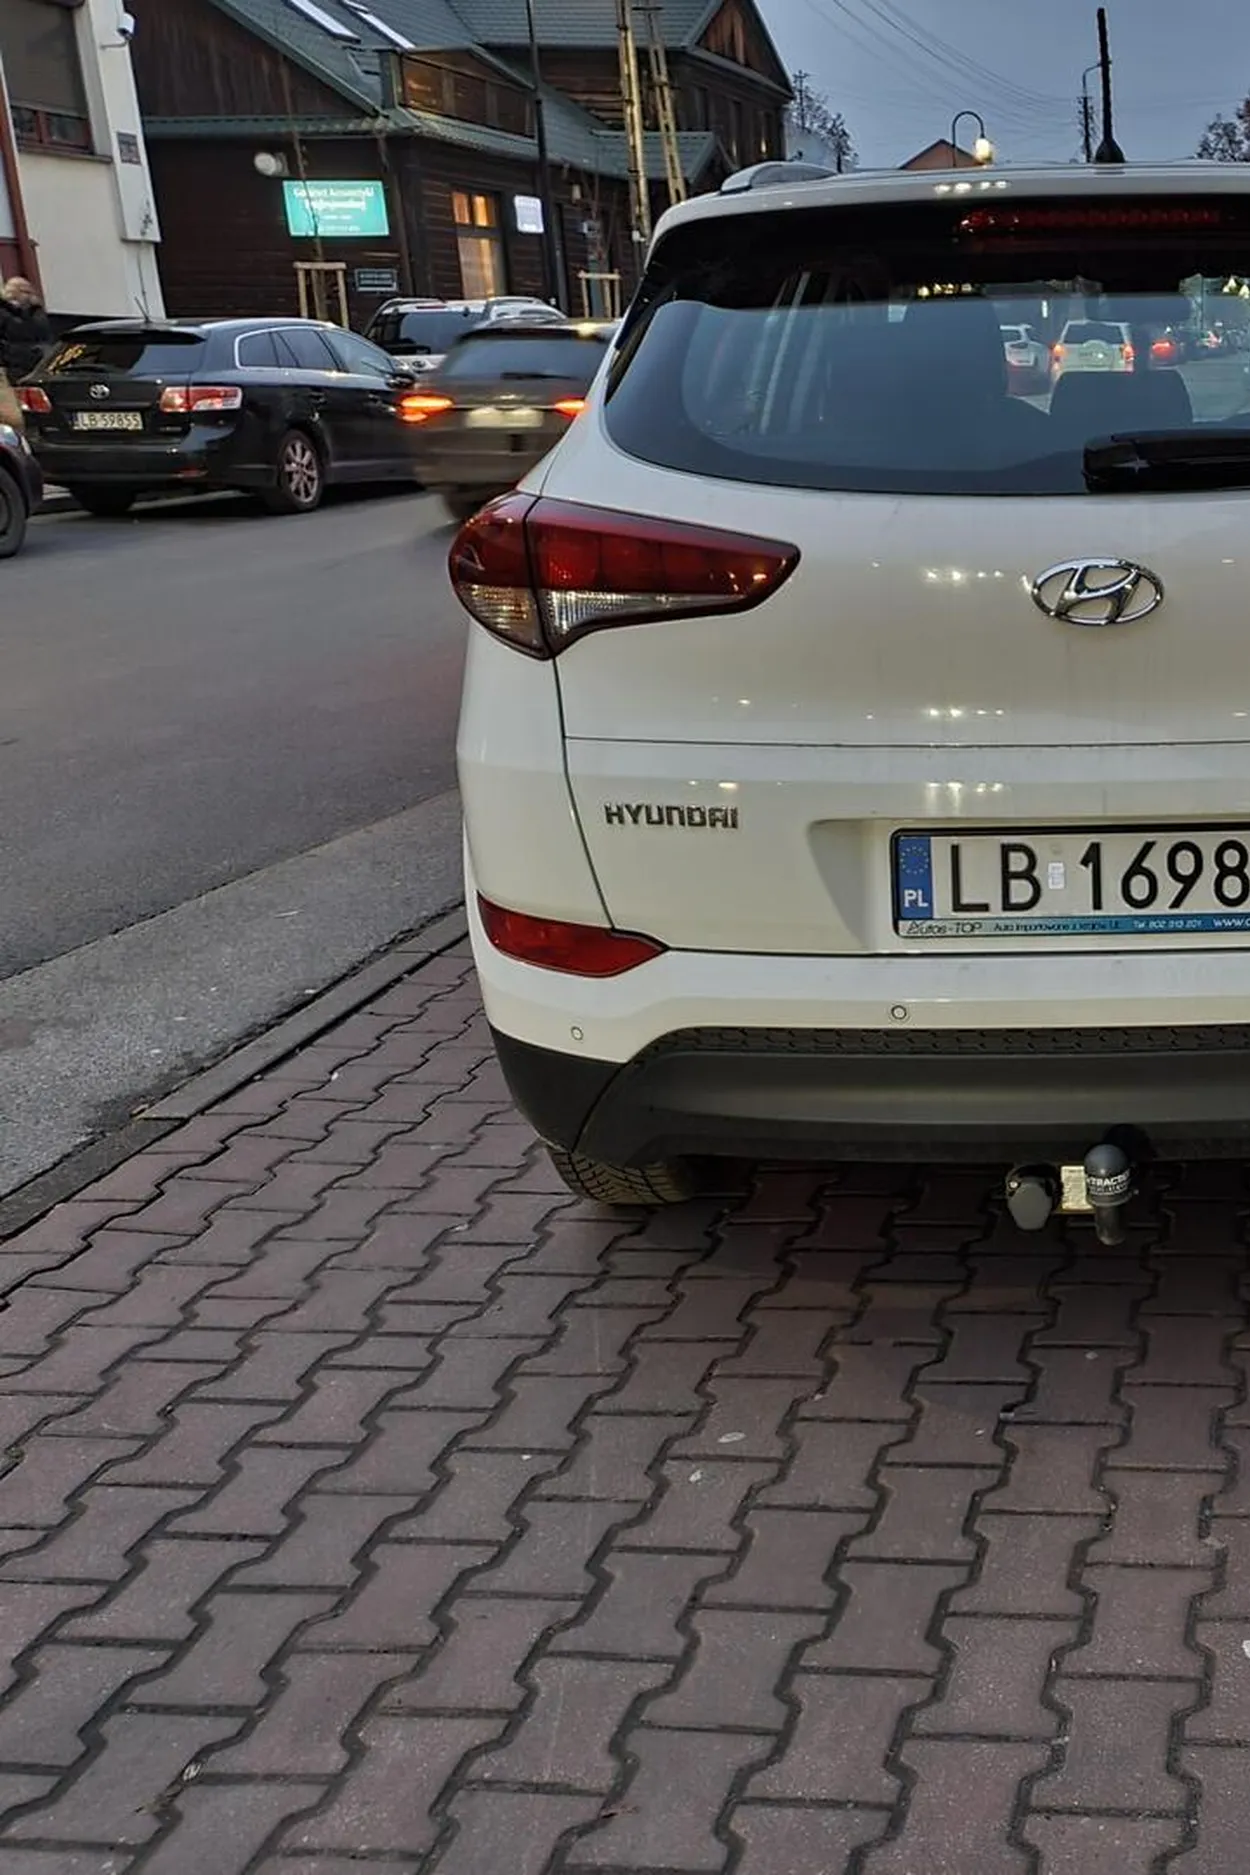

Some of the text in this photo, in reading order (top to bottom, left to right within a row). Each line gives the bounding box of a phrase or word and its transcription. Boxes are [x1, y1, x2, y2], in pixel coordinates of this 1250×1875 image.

[604, 804, 738, 829] HYUNDAI
[950, 842, 1042, 913] LB
[903, 888, 929, 908] PL
